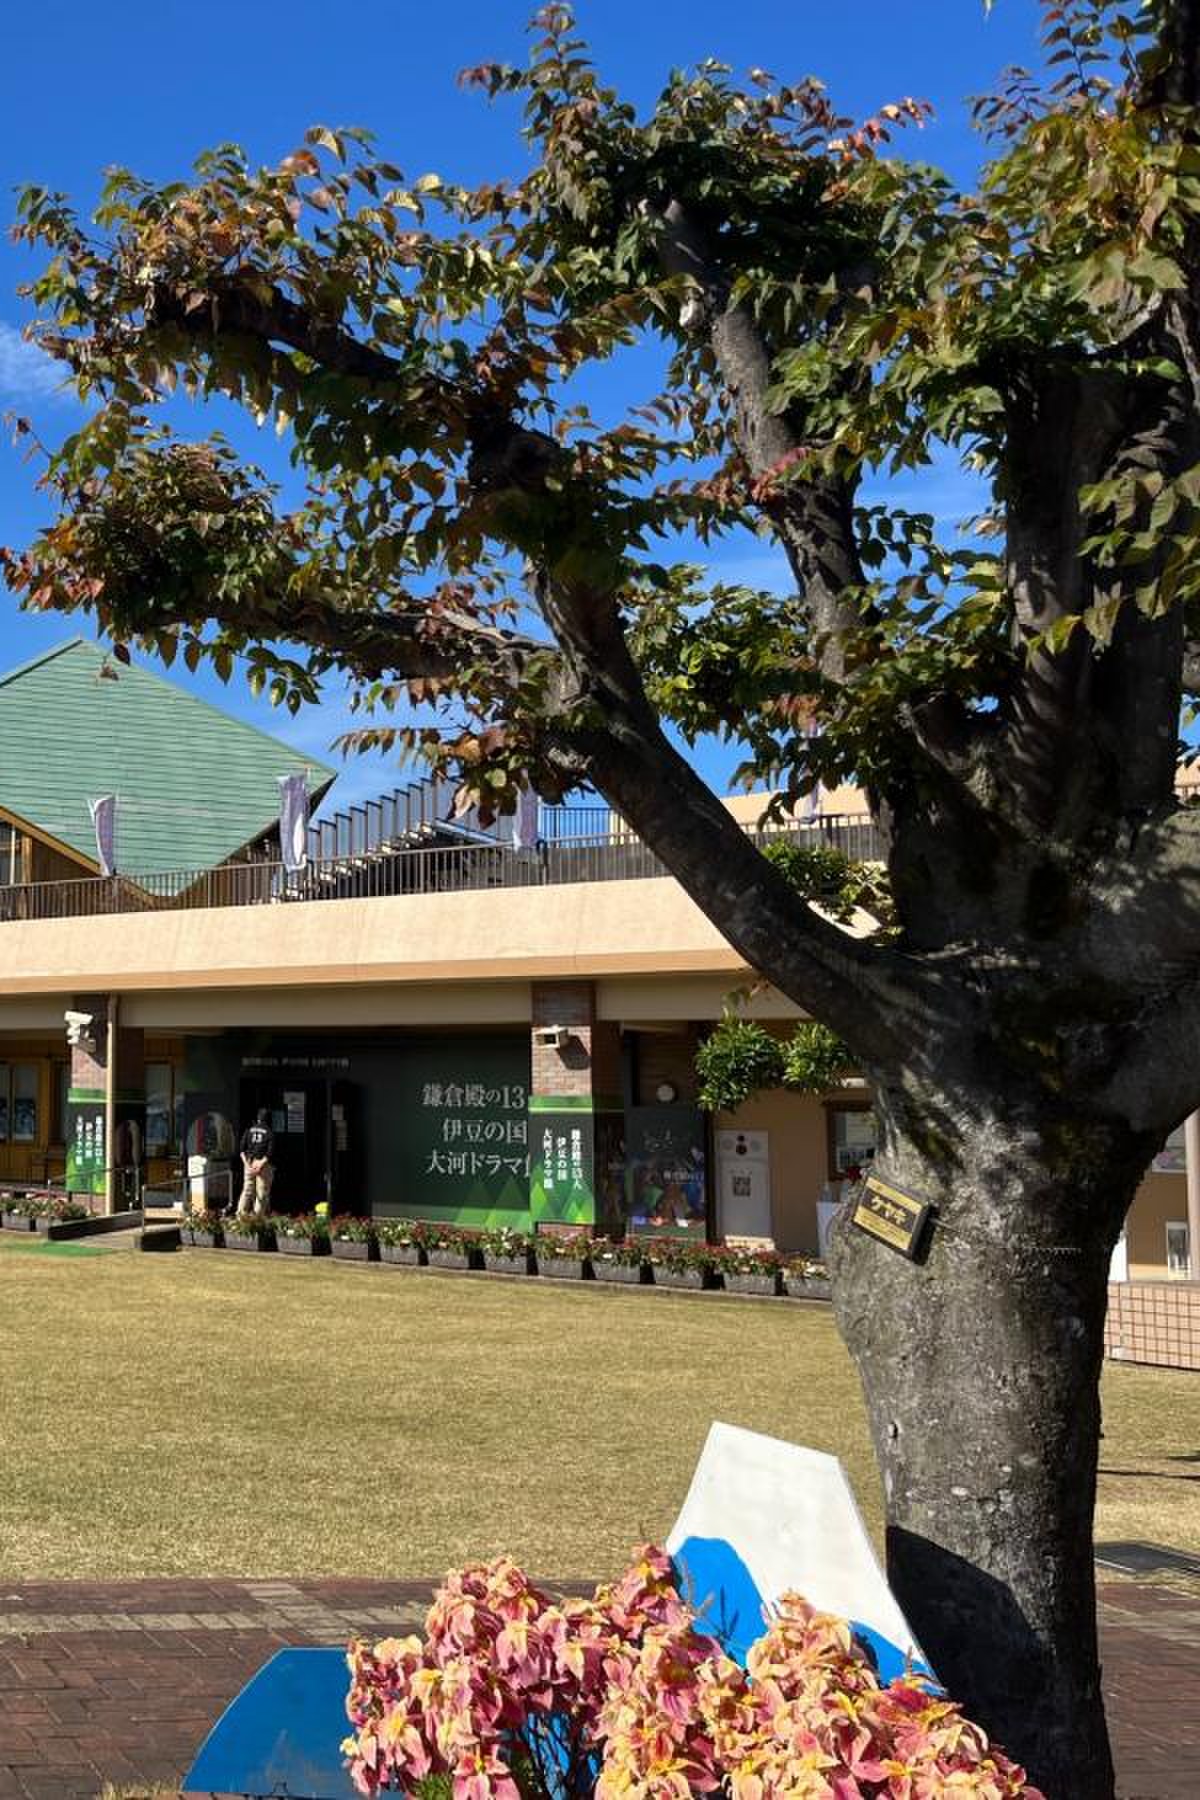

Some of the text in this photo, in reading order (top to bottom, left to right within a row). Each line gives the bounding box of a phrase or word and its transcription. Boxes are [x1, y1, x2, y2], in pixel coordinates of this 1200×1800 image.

[422, 1083, 526, 1109] 鎌倉殿の13
[443, 1118, 528, 1145] 伊豆の国
[425, 1149, 530, 1178] 大河ドラマ
